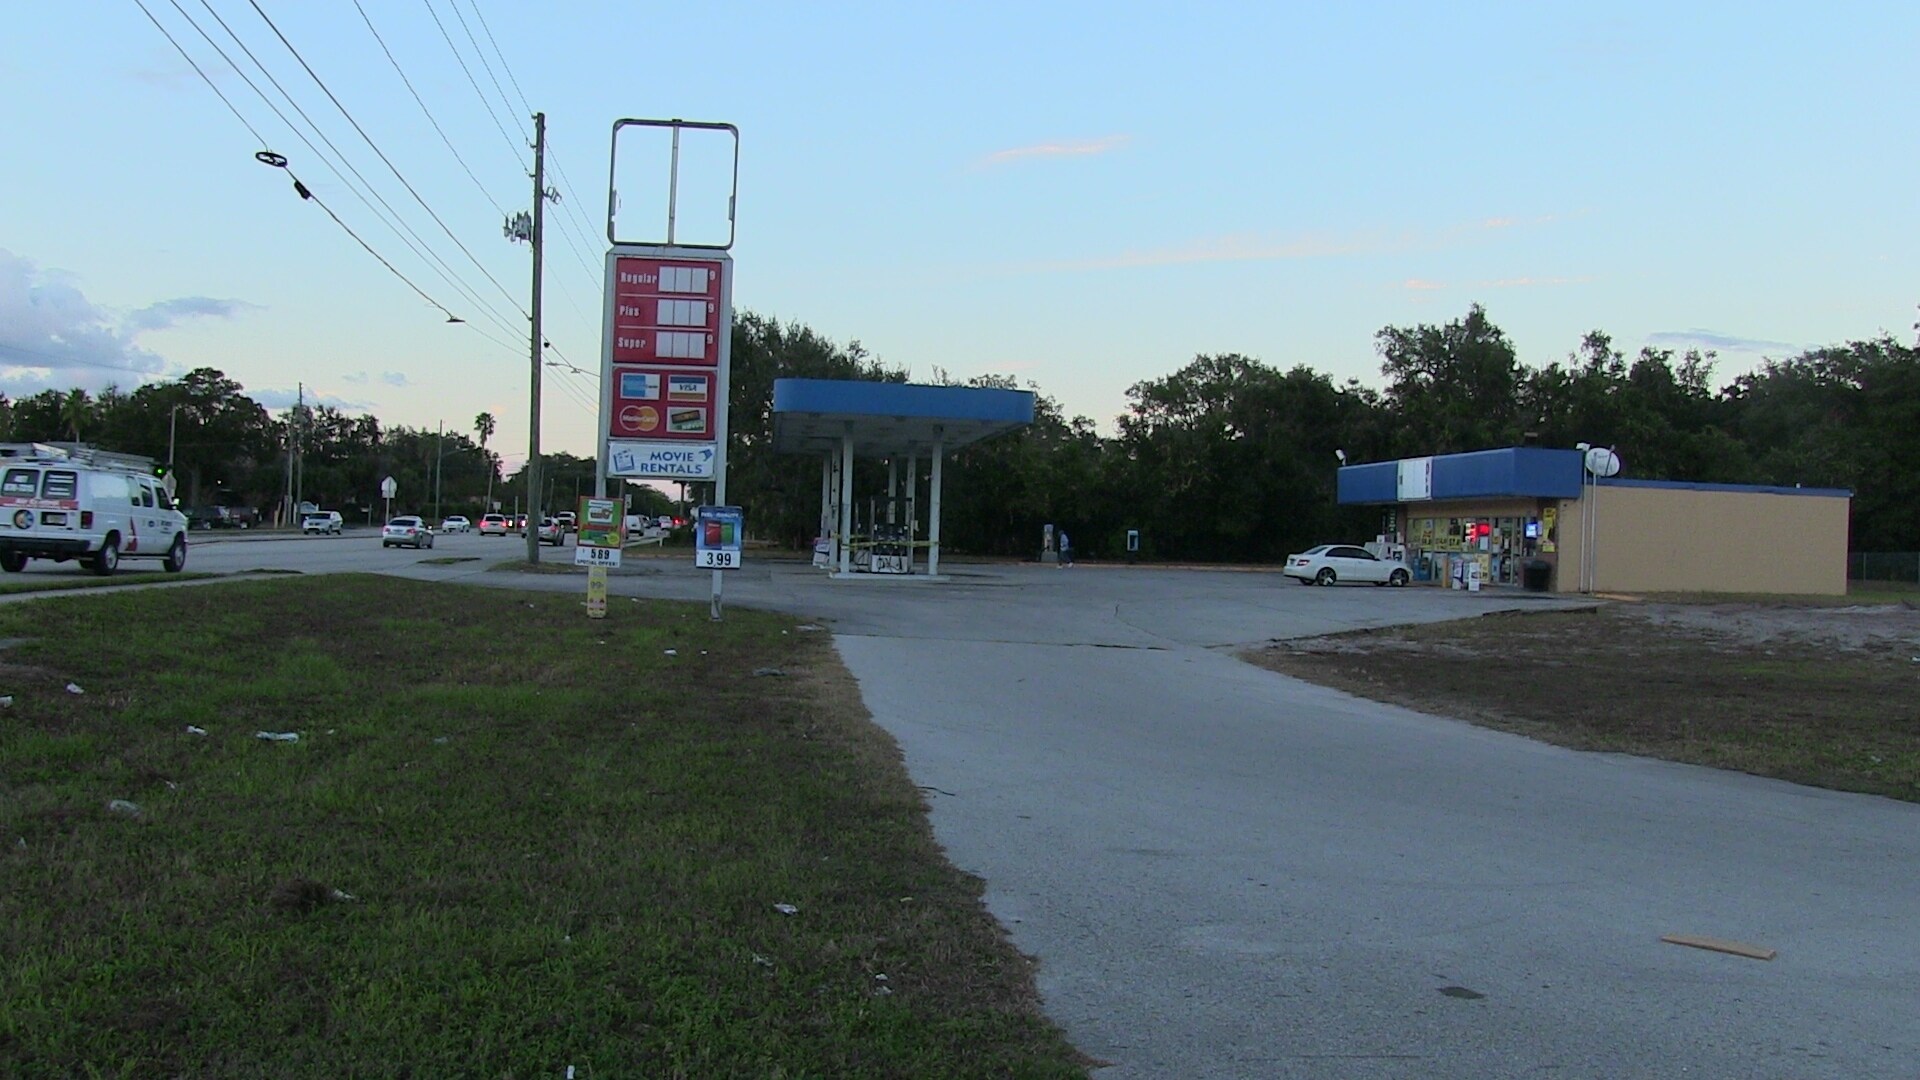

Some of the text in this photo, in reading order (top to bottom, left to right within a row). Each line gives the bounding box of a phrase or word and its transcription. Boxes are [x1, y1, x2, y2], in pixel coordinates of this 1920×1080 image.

[620, 272, 657, 284] Regular
[619, 306, 640, 317] Plus
[618, 337, 646, 349] Super
[679, 384, 697, 392] VISA
[649, 451, 694, 462] MOVIE
[640, 463, 703, 474] RENTALS
